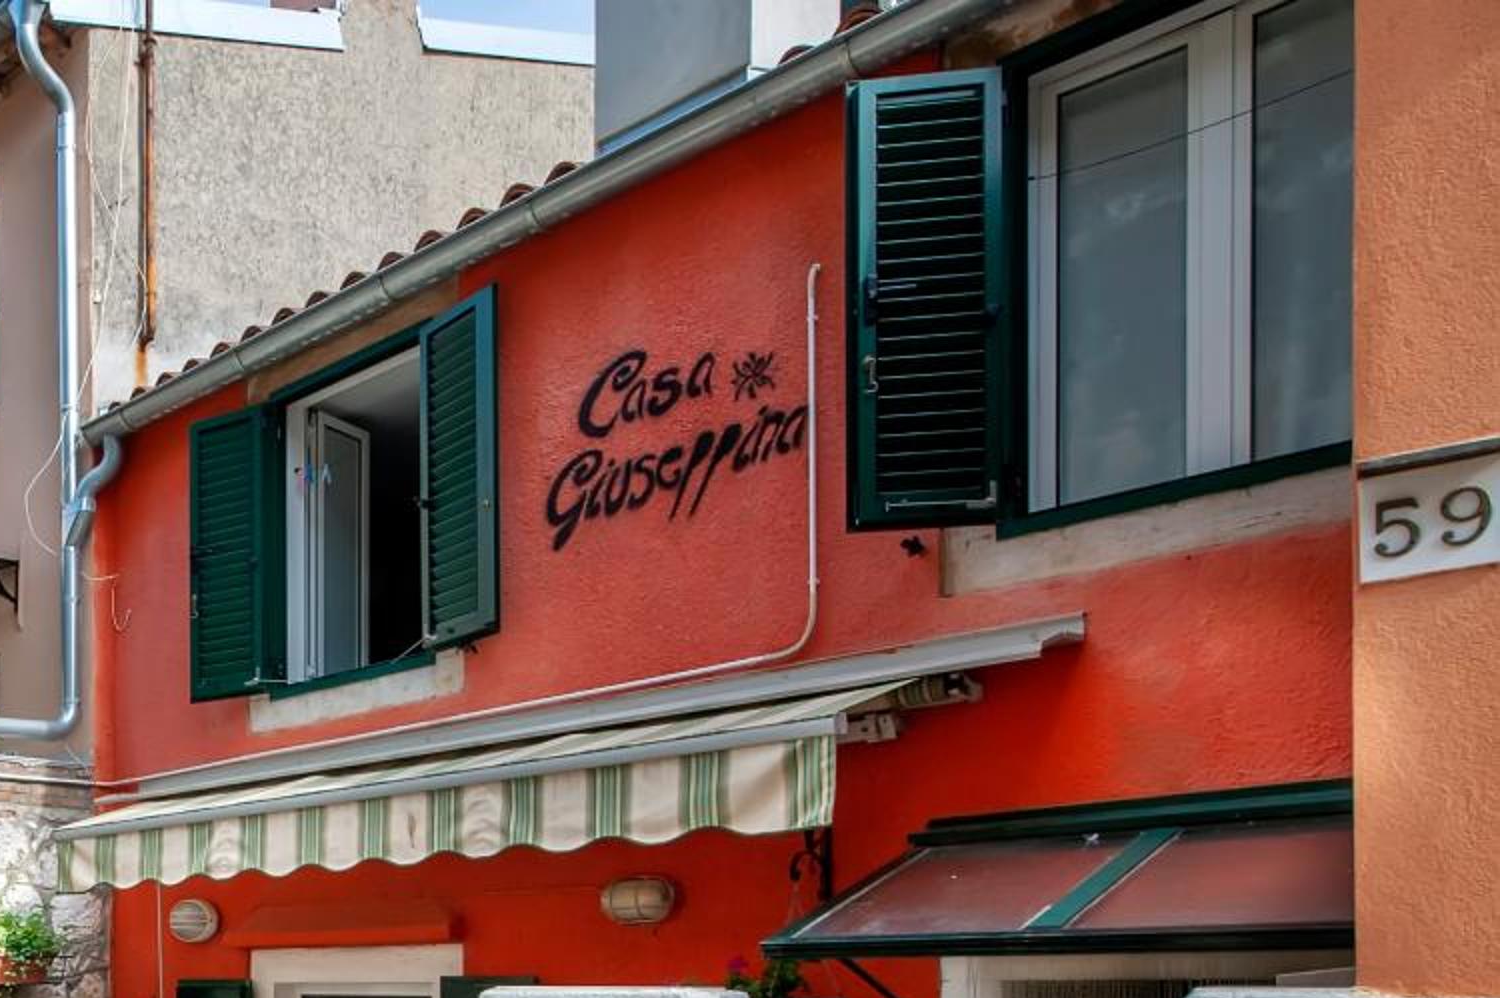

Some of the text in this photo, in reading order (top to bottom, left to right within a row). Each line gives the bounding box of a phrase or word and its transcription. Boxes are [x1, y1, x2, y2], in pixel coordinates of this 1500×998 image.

[577, 351, 716, 438] Casa
[546, 405, 809, 551] Giuseppina
[1374, 486, 1493, 558] 59
